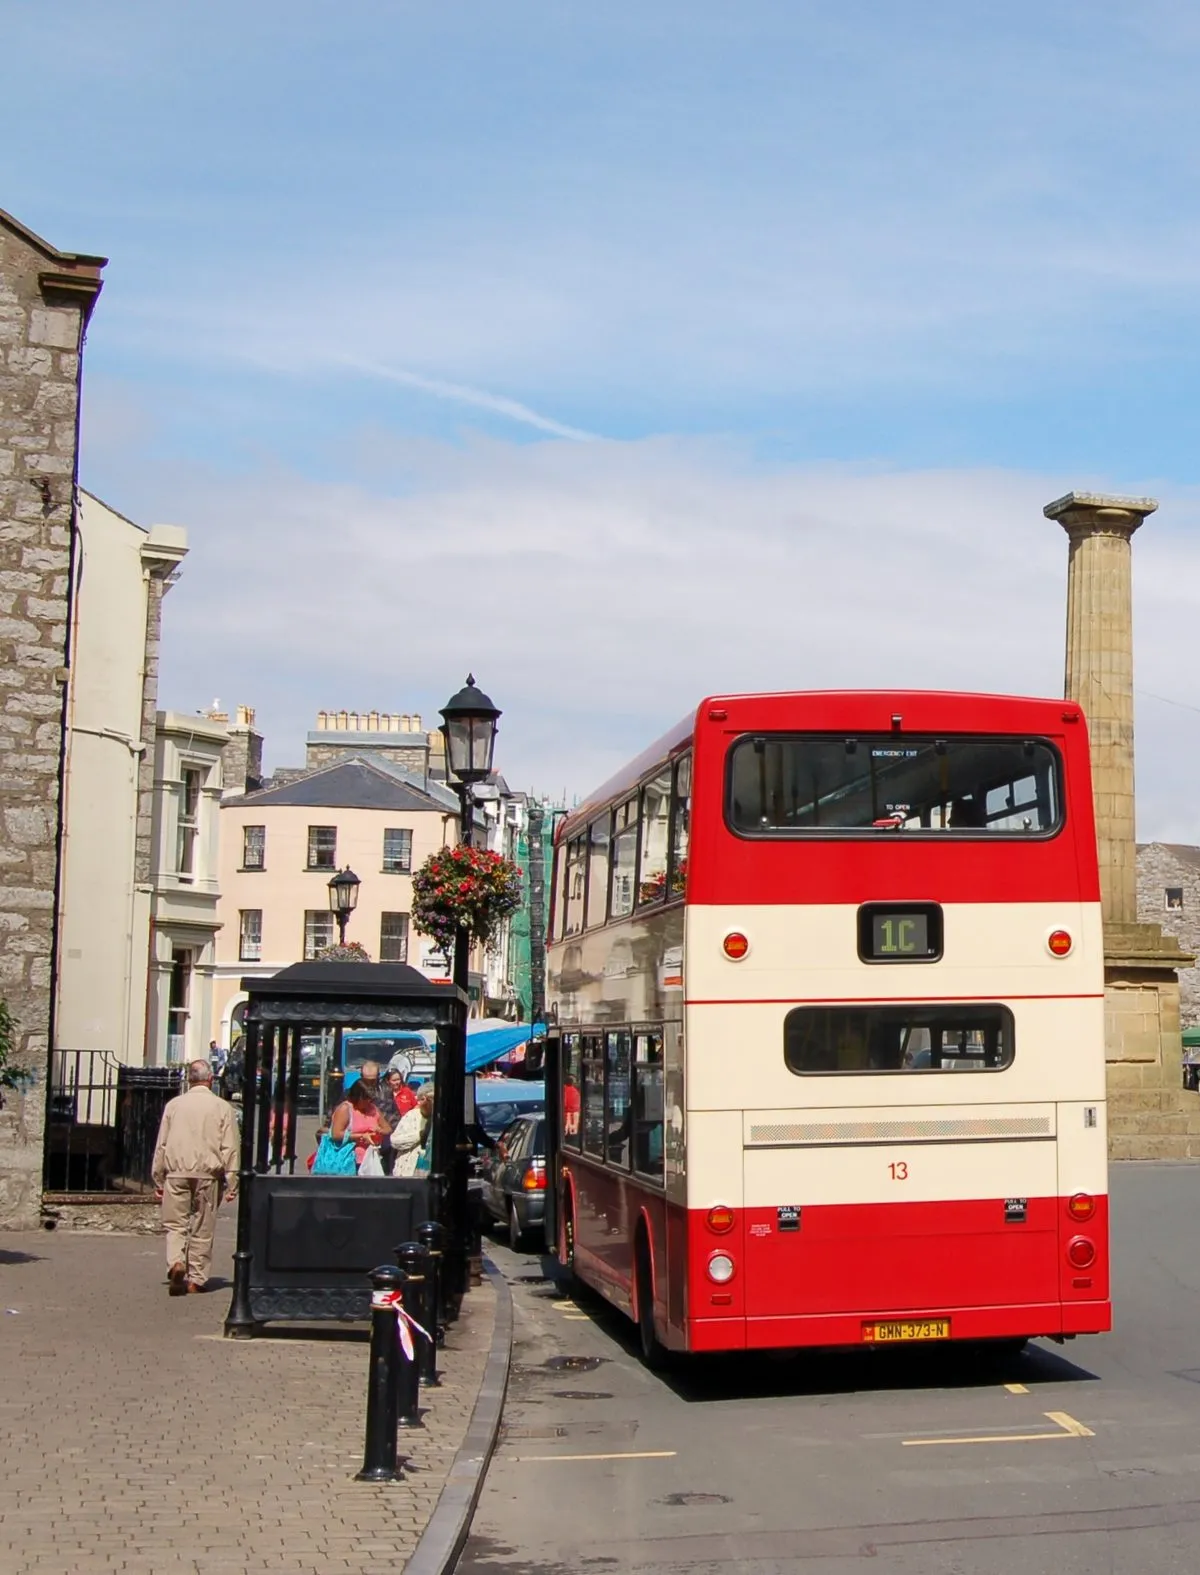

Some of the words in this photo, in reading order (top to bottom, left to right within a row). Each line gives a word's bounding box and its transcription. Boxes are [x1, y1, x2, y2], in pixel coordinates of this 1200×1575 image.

[881, 920, 915, 952] 1C
[888, 1161, 908, 1180] 13
[879, 1323, 944, 1339] GMN-373-N
